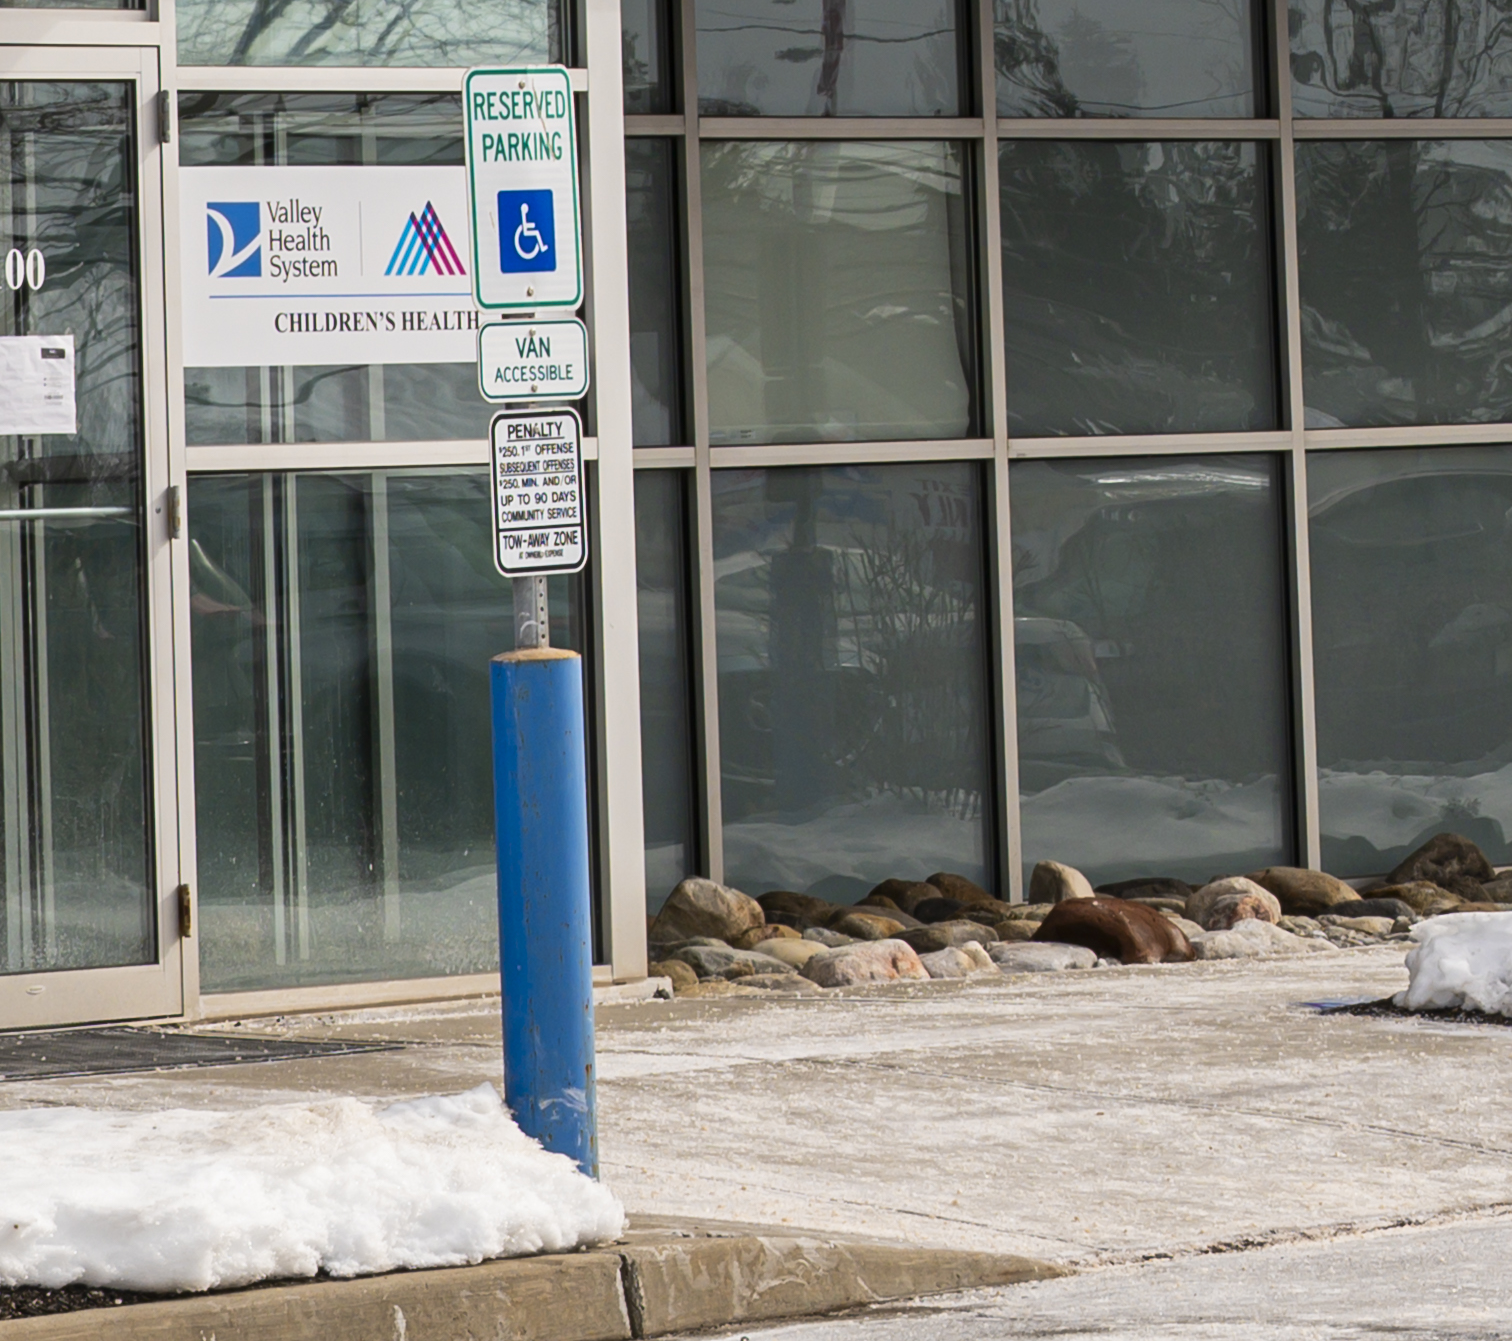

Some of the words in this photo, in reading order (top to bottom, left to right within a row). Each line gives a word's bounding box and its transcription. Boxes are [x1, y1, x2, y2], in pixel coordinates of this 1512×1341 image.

[473, 90, 565, 120] RESERVED
[482, 131, 563, 162] PARKING
[267, 199, 323, 228] Valley
[269, 228, 331, 252] Health
[270, 254, 338, 283] System
[274, 311, 395, 333] CHILDREN'S
[401, 311, 479, 331] HEALTH
[515, 336, 551, 358] VAN
[495, 364, 573, 383] ACCESSIBLE
[508, 421, 562, 439] PENALTY
[535, 442, 574, 455] OFFENSE
[500, 460, 540, 474] SUBSEQUENT
[542, 458, 574, 471] OFFENSES
[499, 478, 520, 489] $250.
[543, 475, 576, 486] AND/OR
[501, 494, 514, 506] UP
[517, 493, 530, 505] TO
[534, 492, 547, 504] 90
[551, 490, 576, 503] DAYS
[502, 509, 544, 523] COMMUNITY
[547, 506, 577, 519] SERVICE
[503, 532, 550, 550] TOW-AWAY
[554, 530, 578, 546] ZONE
